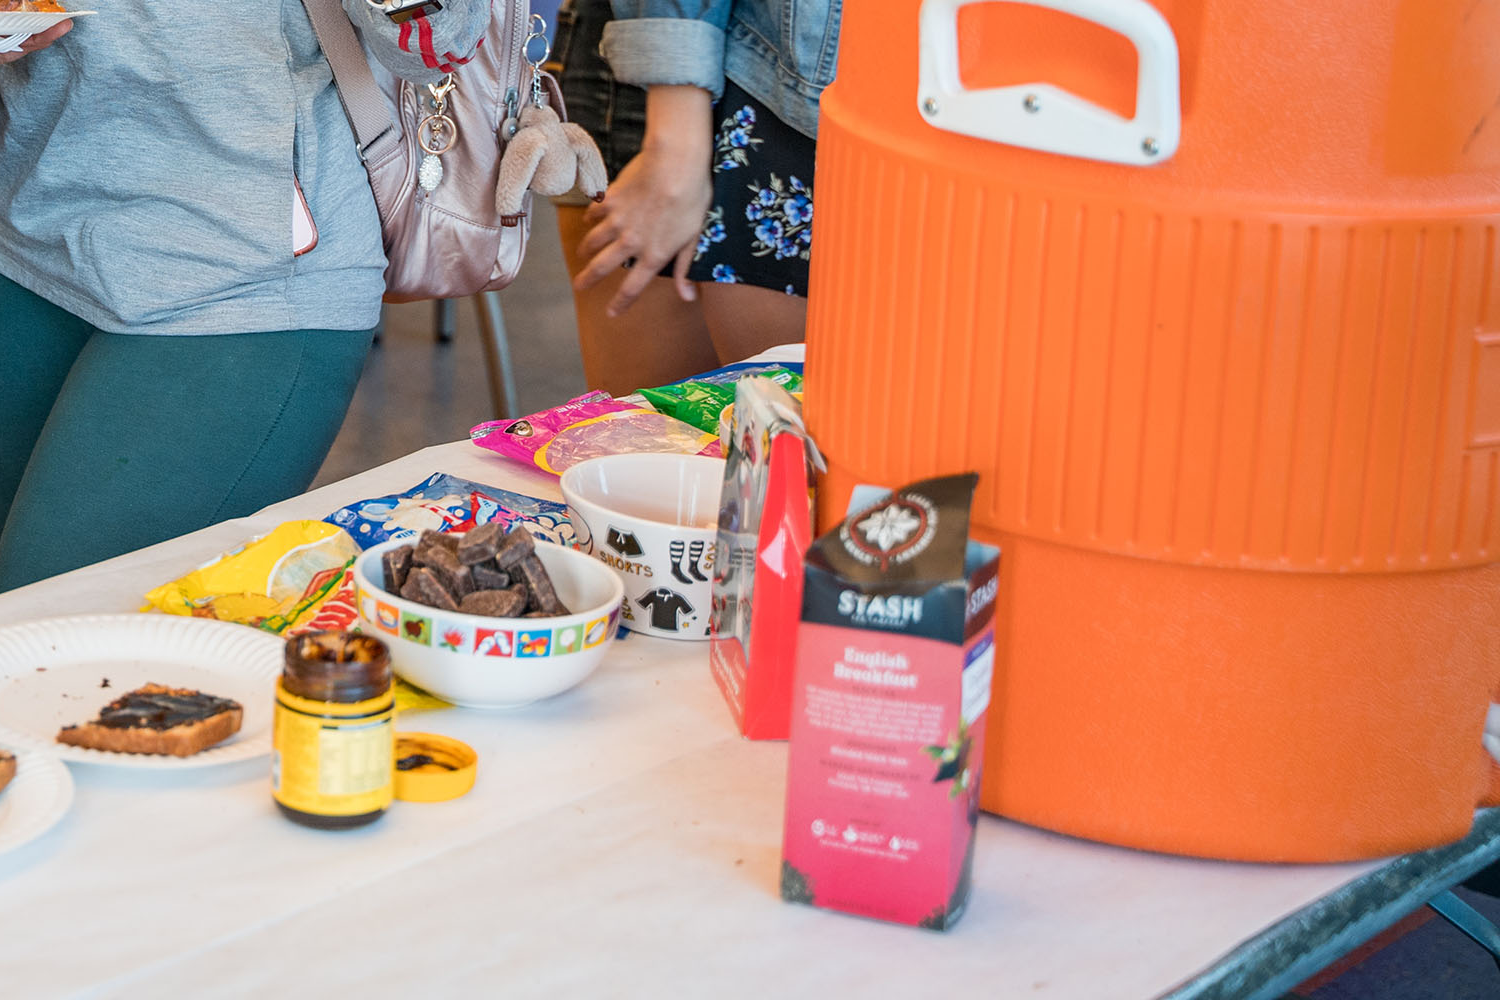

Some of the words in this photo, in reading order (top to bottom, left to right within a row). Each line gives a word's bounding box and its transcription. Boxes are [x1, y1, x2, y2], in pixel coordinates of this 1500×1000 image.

[599, 551, 653, 577] SHORTS
[837, 590, 925, 623] STASH
[843, 647, 909, 669] English
[833, 662, 918, 688] Breakfast
